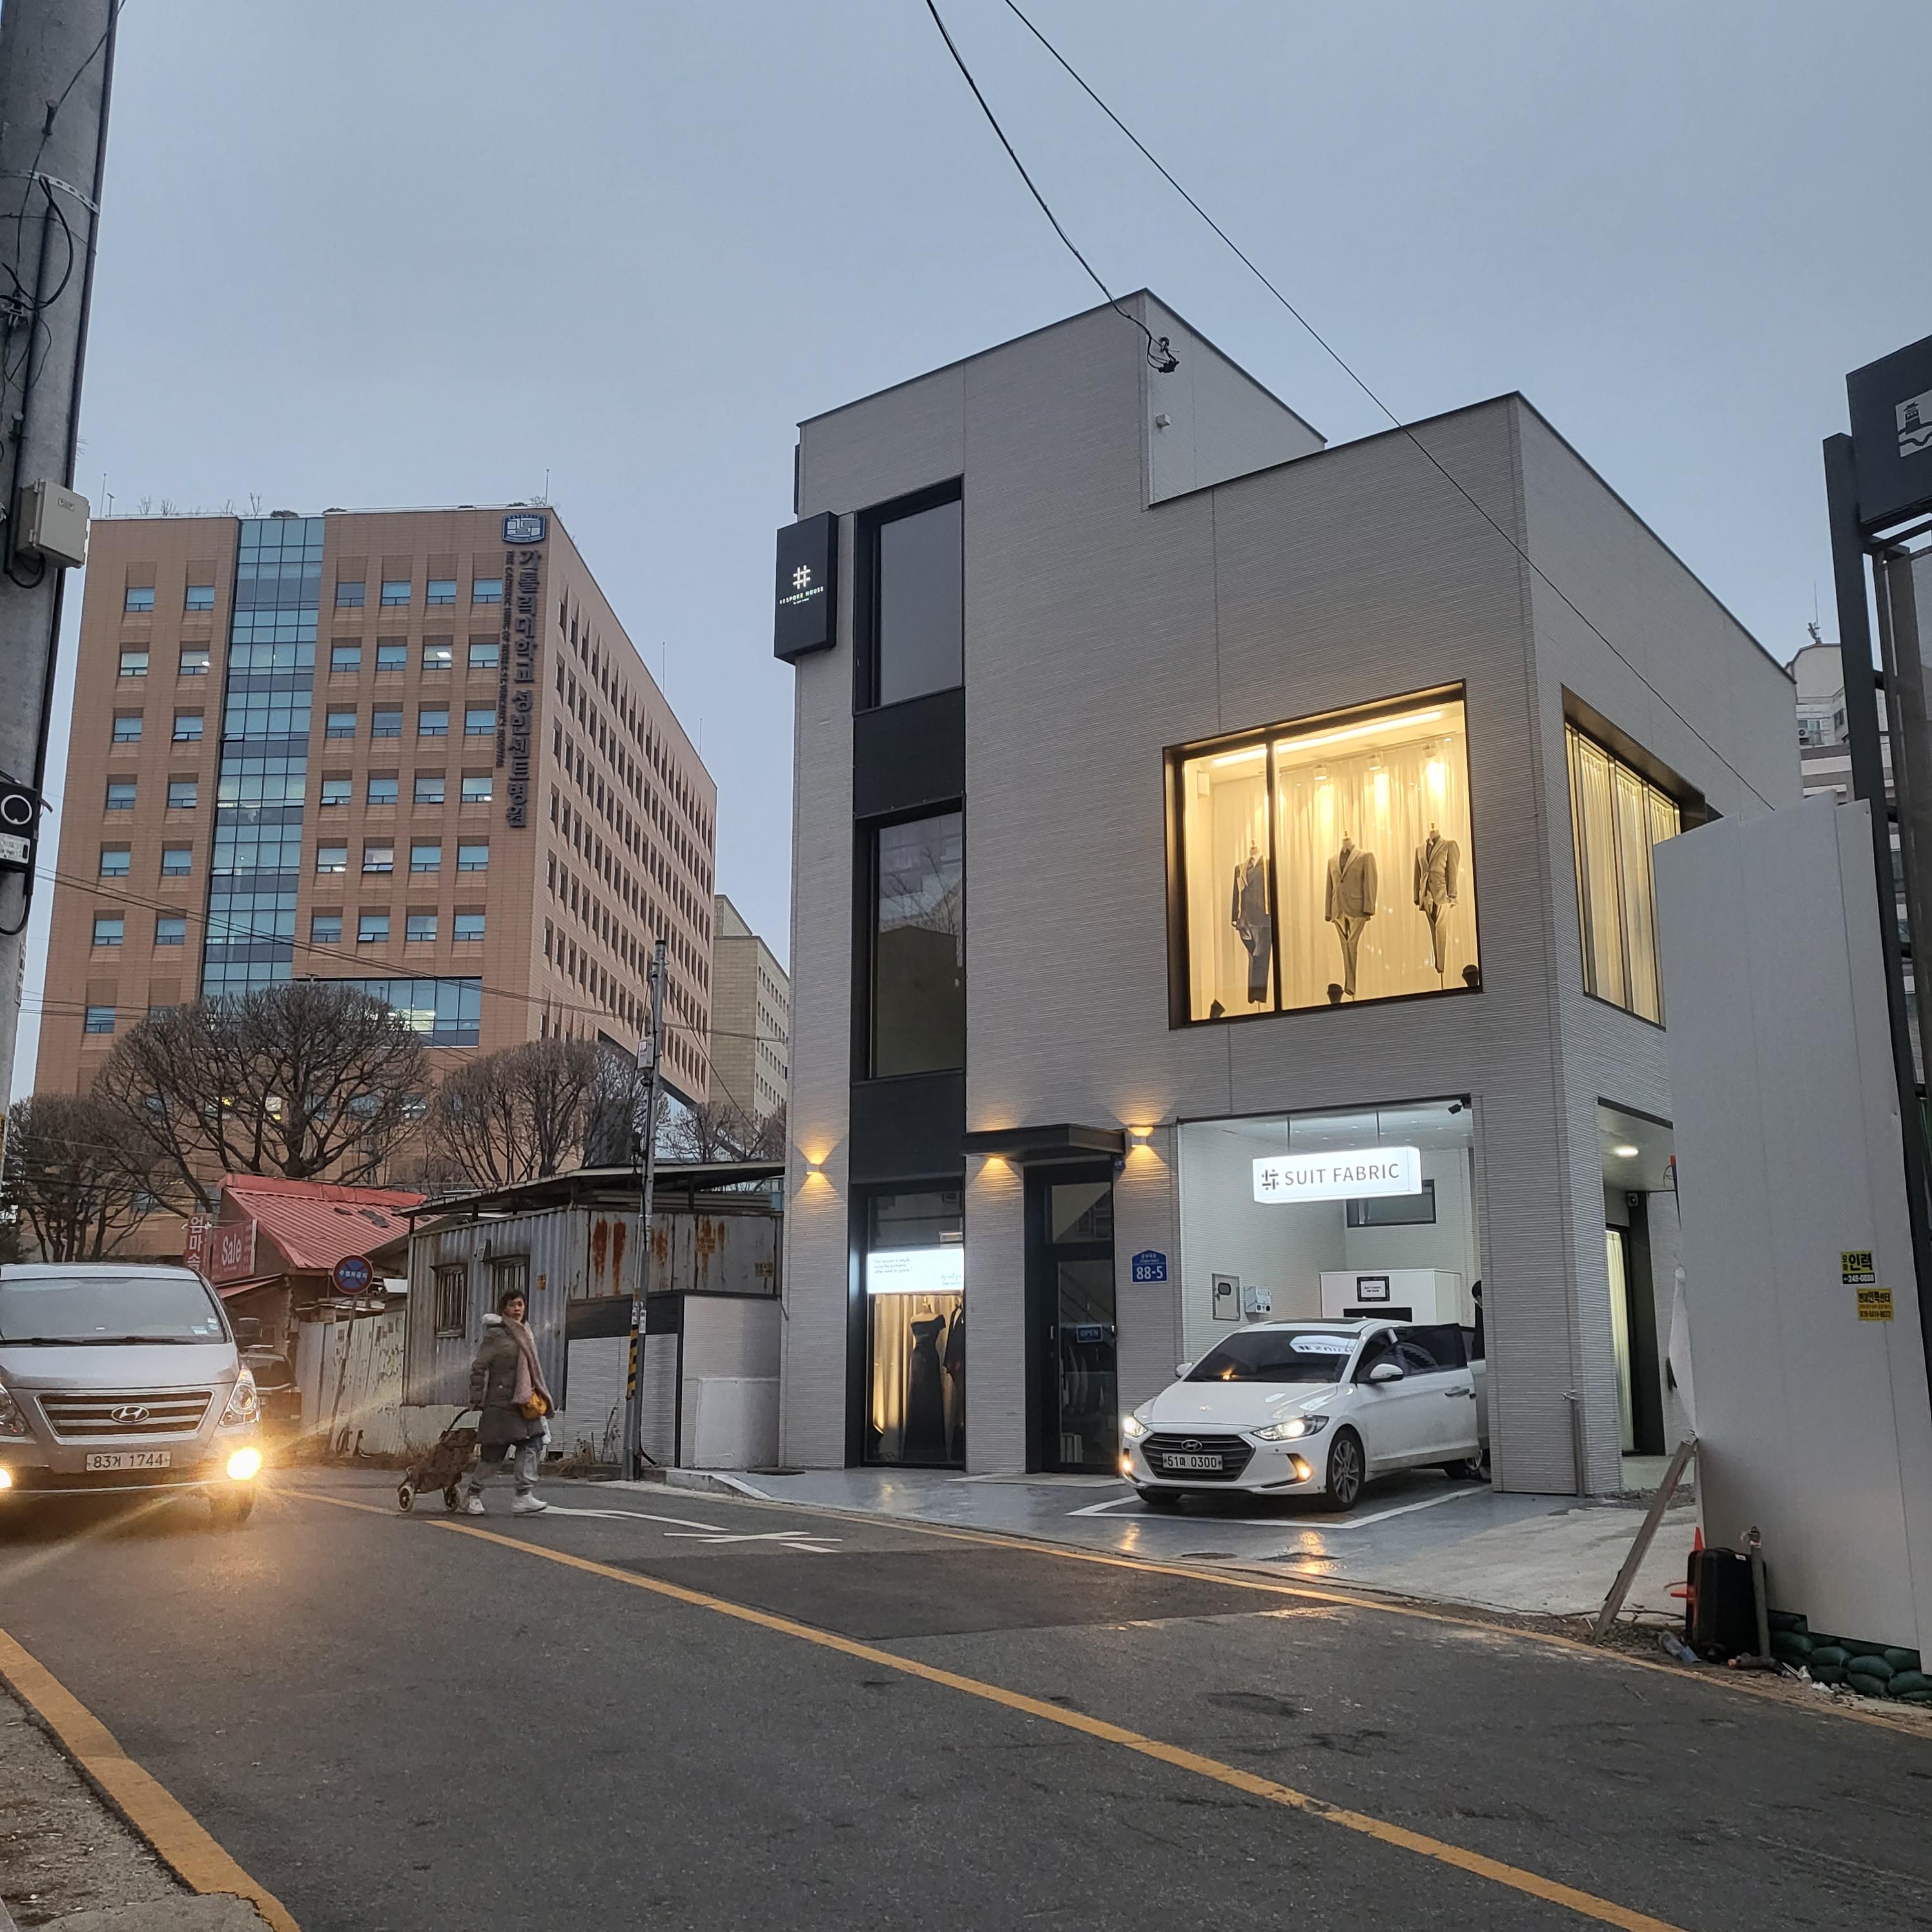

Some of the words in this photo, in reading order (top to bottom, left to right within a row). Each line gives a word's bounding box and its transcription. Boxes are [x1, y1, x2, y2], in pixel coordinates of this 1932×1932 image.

[779, 593, 803, 604] BESPOKE
[805, 586, 824, 597] HOUSE
[513, 550, 542, 683] 가톨릭대학교
[506, 689, 532, 828] 성빈센트병원
[1285, 1169, 1326, 1186] SUIT
[1333, 1163, 1400, 1183] FABRIC
[222, 1233, 242, 1266] Sale
[1849, 1253, 1873, 1271] 인력
[339, 1269, 367, 1281] 주정차금지
[1136, 1266, 1163, 1280] 88-5
[129, 1454, 163, 1467] 1744
[1167, 1455, 1186, 1467] 51마
[1191, 1457, 1217, 1468] 0300
